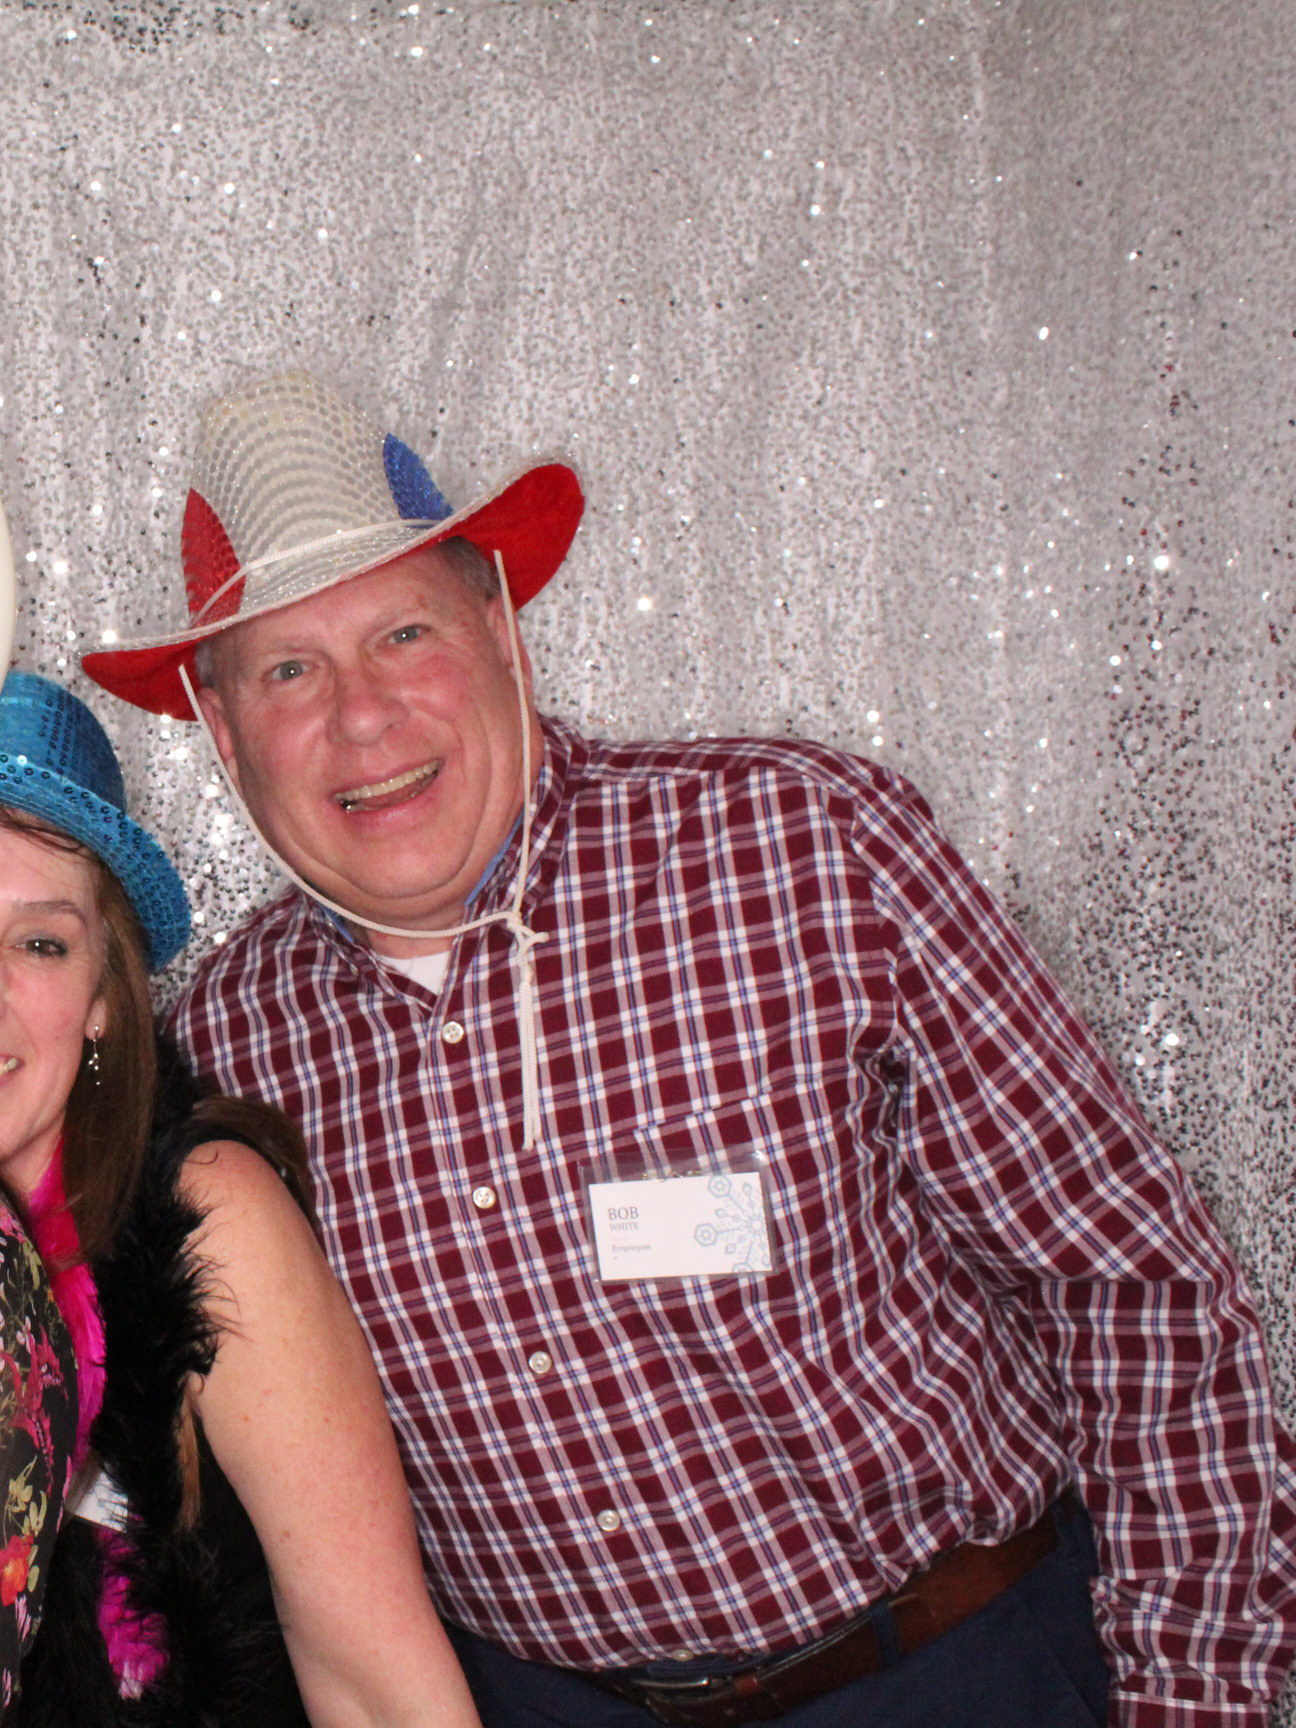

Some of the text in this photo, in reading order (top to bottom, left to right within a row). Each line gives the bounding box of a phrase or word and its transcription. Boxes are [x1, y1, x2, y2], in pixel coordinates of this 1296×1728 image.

[608, 1206, 640, 1221] BOB
[609, 1222, 640, 1231] WHITE
[612, 1244, 651, 1254] Employee
